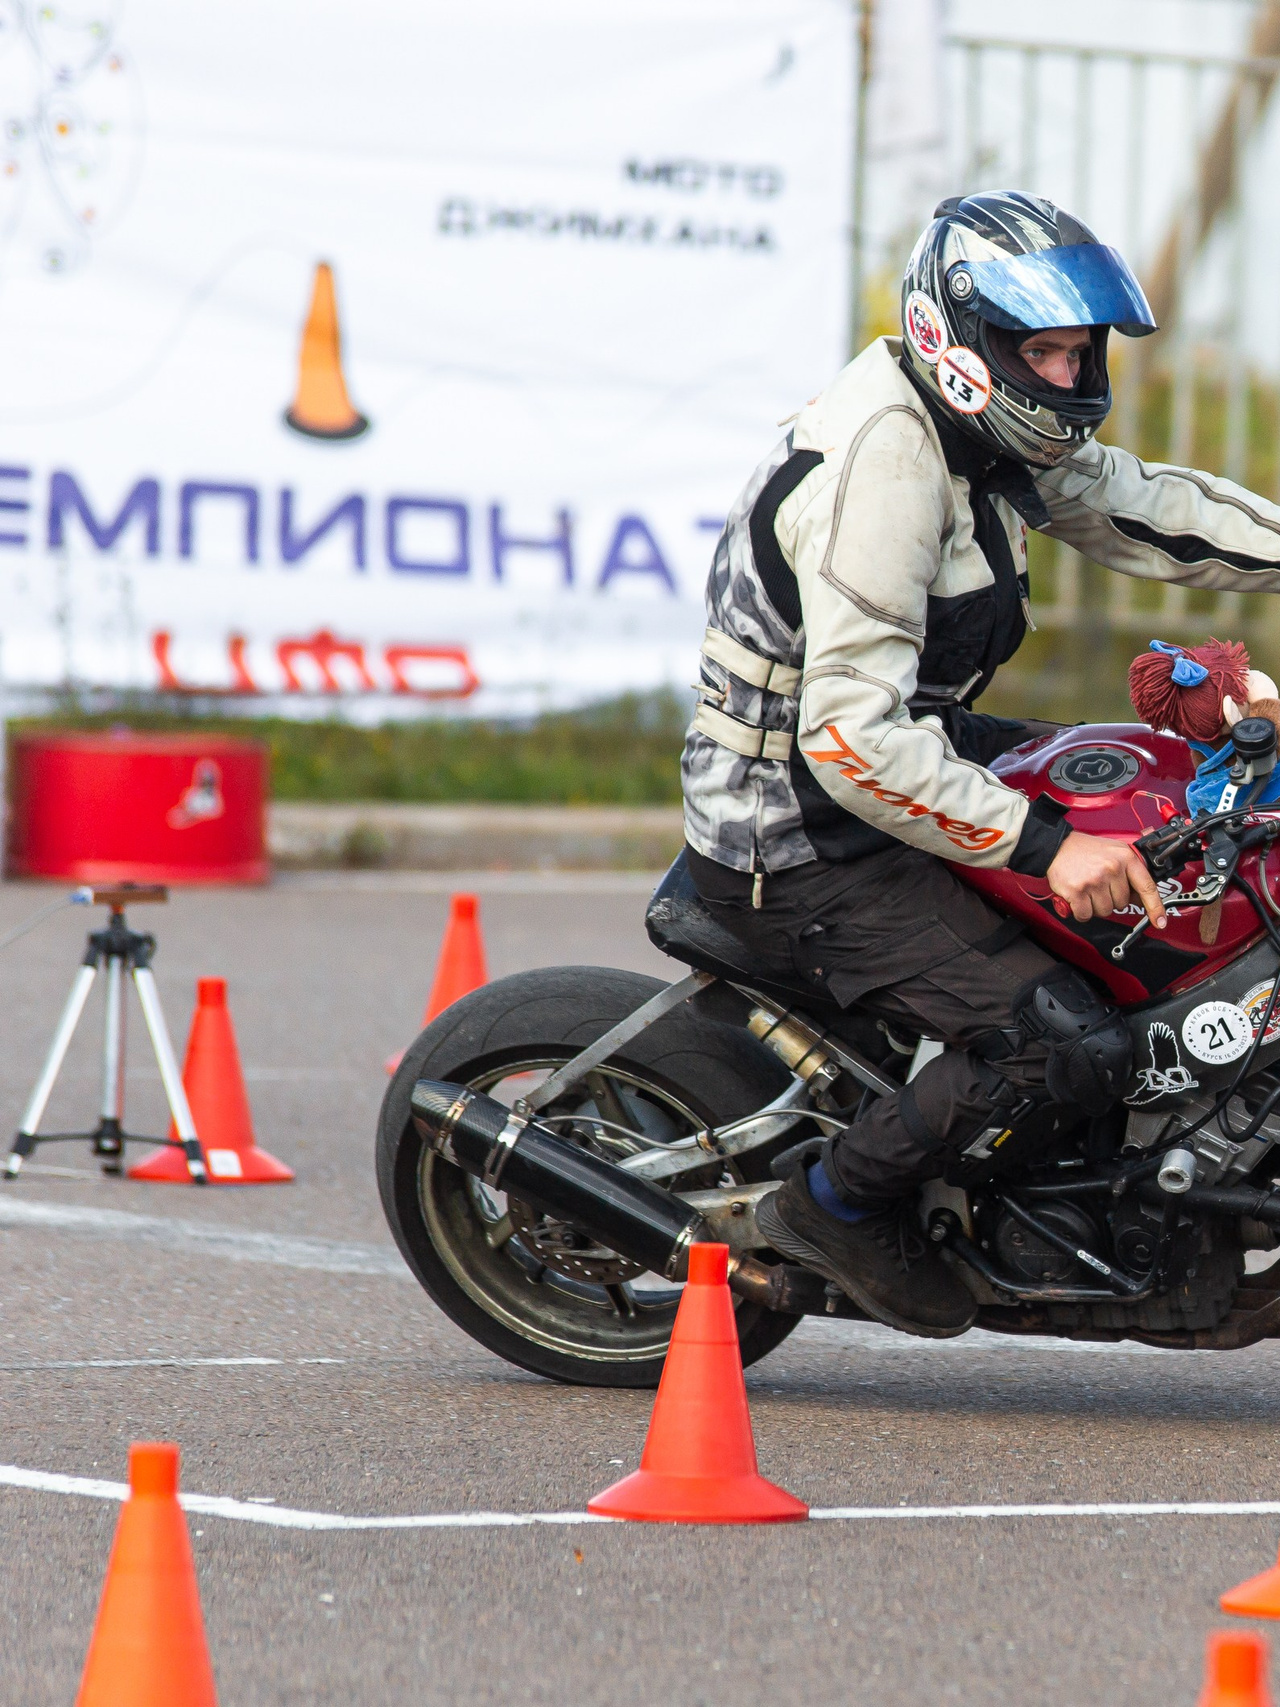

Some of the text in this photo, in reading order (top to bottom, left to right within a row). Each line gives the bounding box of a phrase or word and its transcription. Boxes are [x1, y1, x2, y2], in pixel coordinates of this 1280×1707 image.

[624, 156, 783, 199] МОТО
[946, 374, 973, 402] 13
[1200, 1017, 1237, 1050] 21
